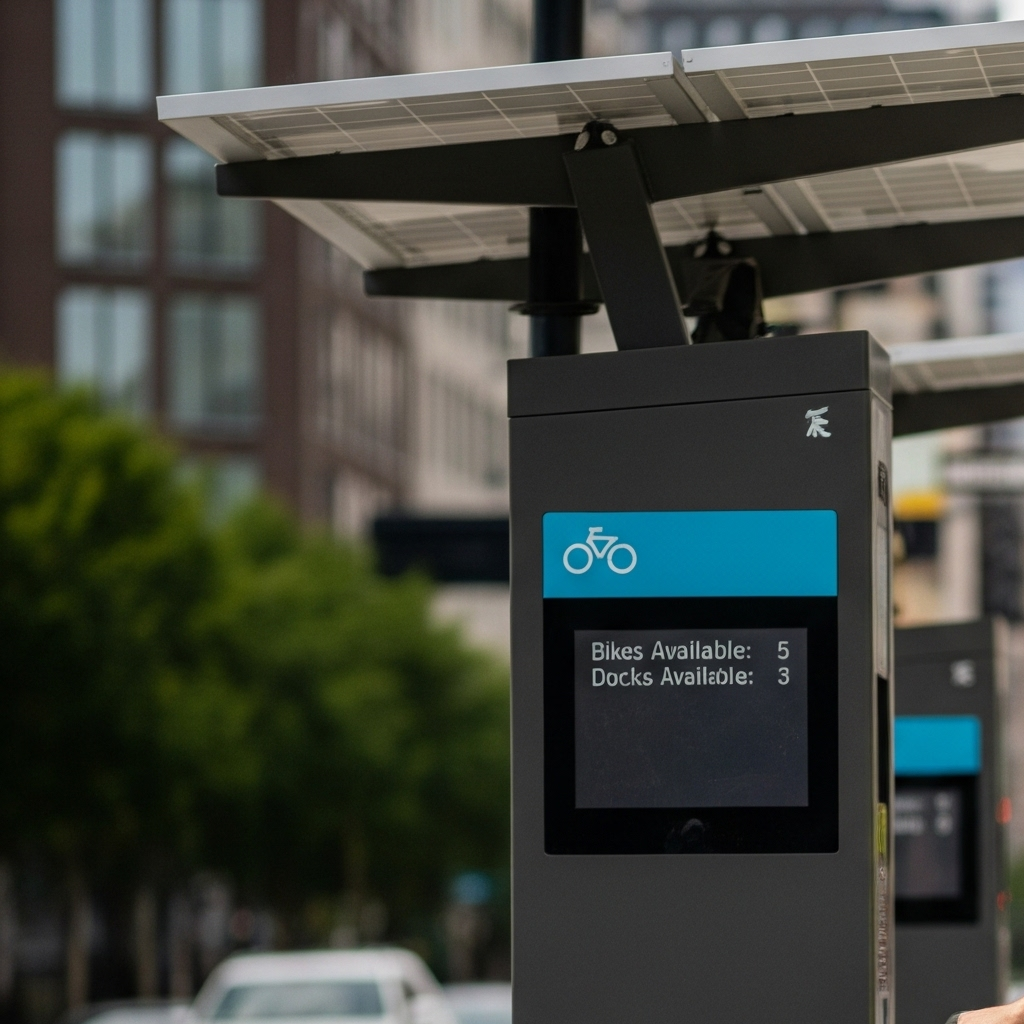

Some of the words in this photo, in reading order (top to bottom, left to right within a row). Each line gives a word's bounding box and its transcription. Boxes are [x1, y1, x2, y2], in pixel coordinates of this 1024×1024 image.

[591, 641, 644, 661] Bikes
[651, 640, 751, 660] Available:
[777, 641, 790, 660] 5
[591, 667, 654, 687] Docks
[660, 666, 754, 686] Available:
[777, 667, 790, 685] 3
